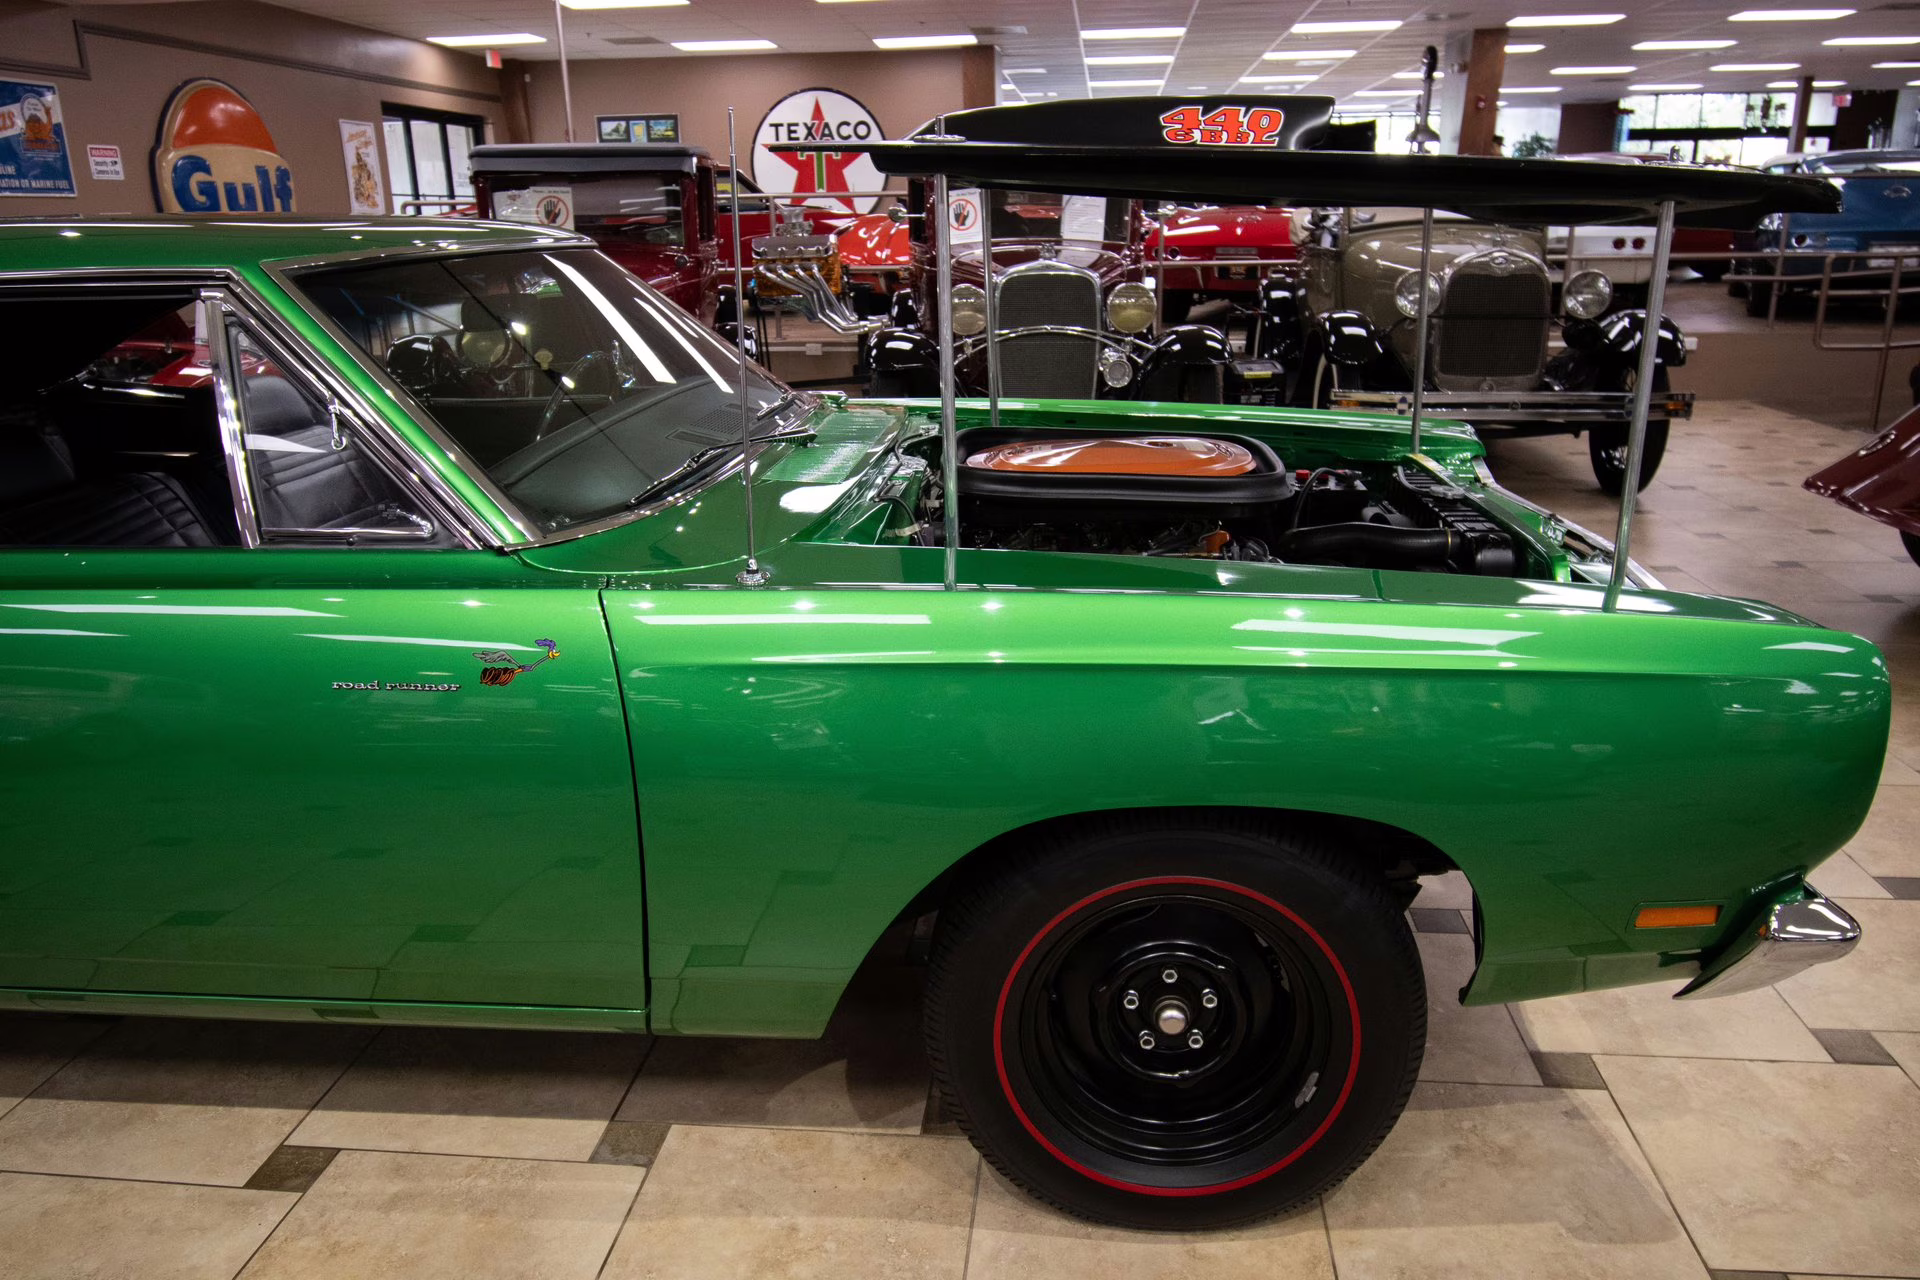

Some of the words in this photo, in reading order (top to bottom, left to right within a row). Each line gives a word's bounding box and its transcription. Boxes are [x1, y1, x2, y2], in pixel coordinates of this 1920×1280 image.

[1160, 106, 1284, 133] 440
[769, 120, 872, 141] TEXACO
[21, 179, 30, 188] OR
[31, 180, 55, 189] MARINE
[56, 180, 70, 189] FUEL
[171, 155, 292, 212] Gulf
[331, 680, 380, 690] road
[385, 682, 460, 691] runner
